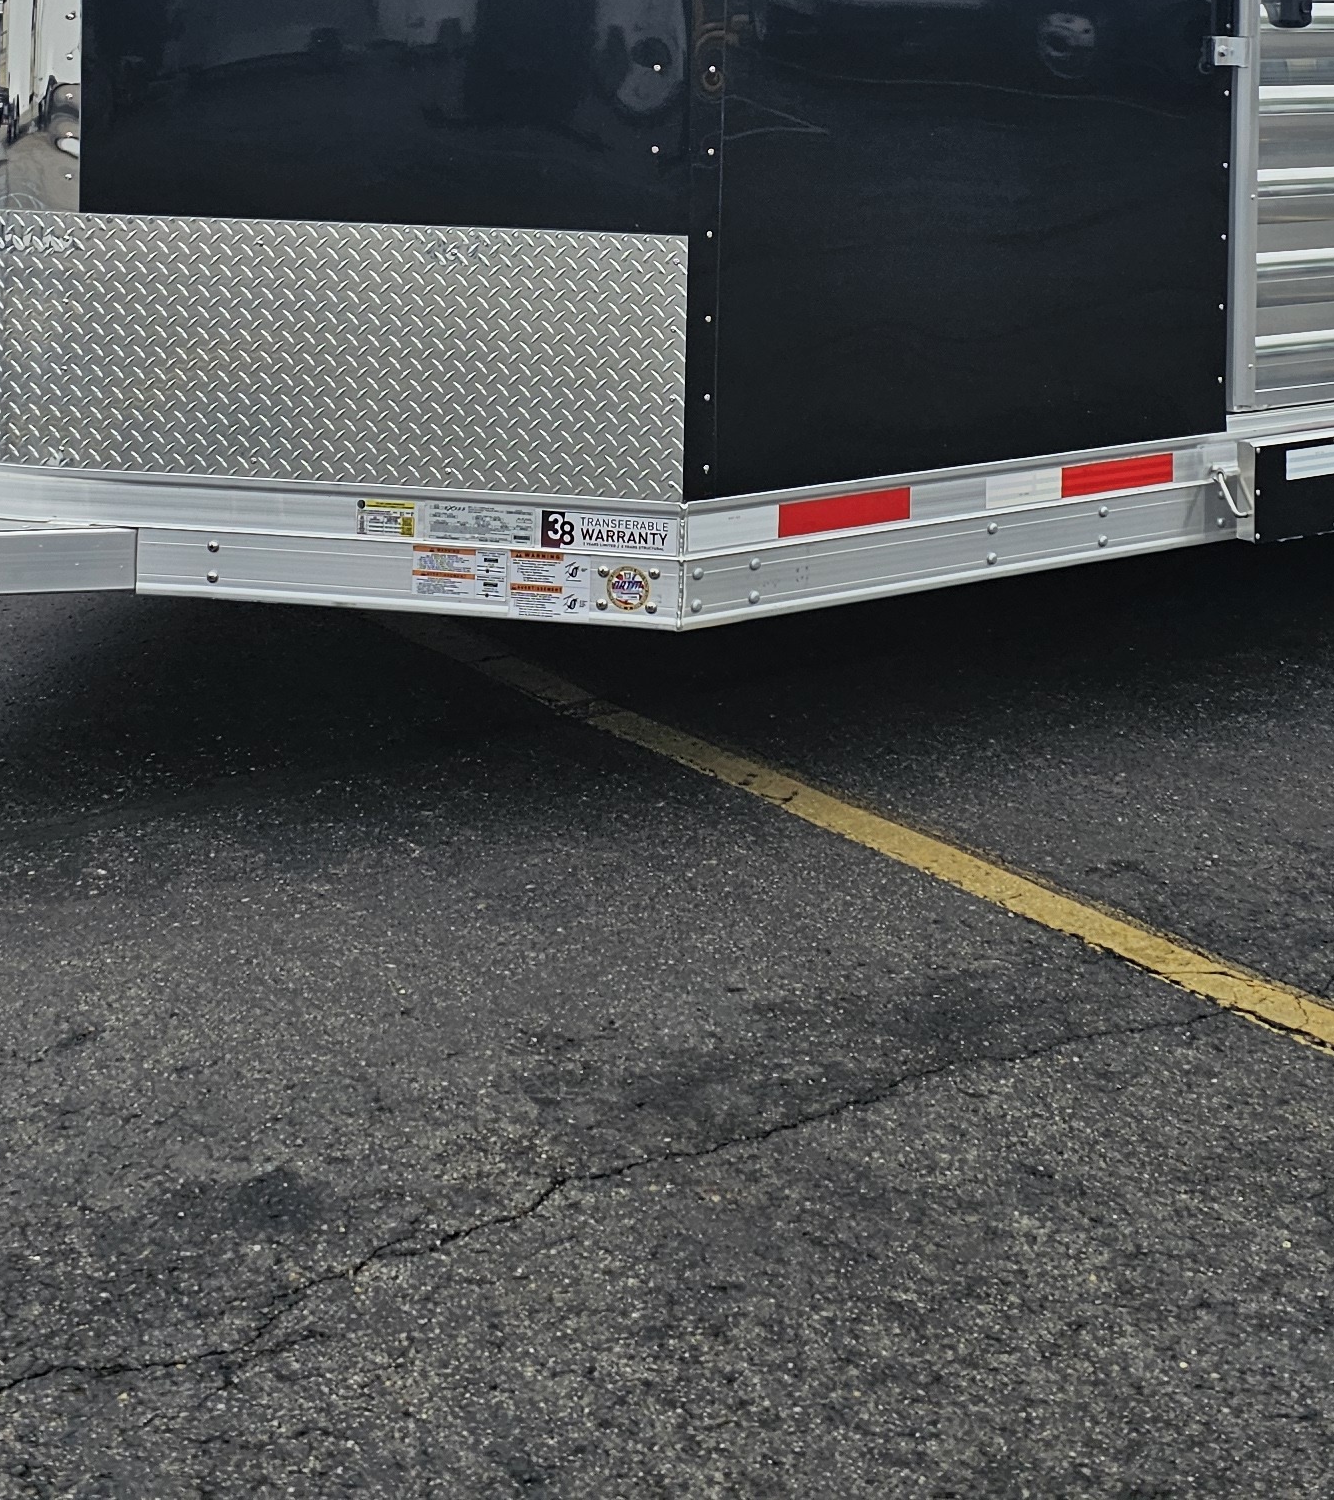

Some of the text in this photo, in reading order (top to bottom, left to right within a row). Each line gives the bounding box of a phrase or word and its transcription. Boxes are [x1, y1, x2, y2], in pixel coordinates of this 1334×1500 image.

[547, 513, 575, 546] 38
[580, 516, 669, 533] TRANSFERABLE
[580, 527, 668, 547] WARRANTY
[524, 552, 561, 560] WARNING
